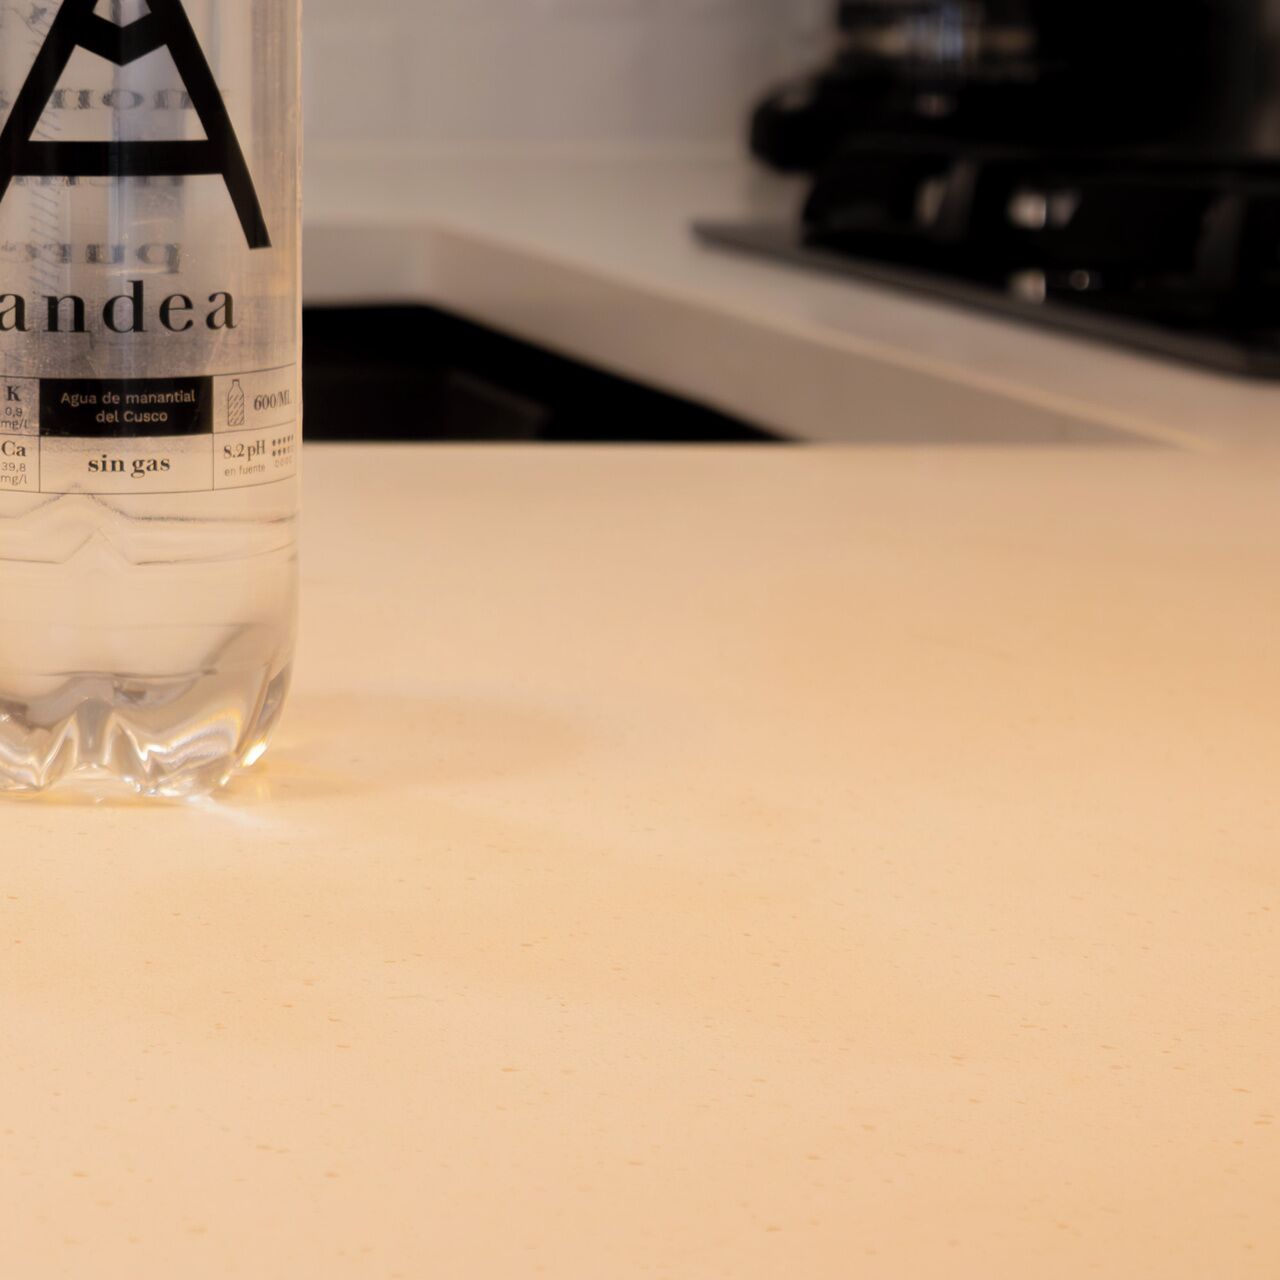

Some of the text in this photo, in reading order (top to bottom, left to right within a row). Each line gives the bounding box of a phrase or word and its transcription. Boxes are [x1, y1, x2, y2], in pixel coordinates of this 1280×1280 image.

[7, 385, 21, 402] K
[60, 390, 196, 407] Agua de manantial
[5, 407, 22, 418] 0,9
[95, 410, 168, 423] del Cusco
[1, 419, 28, 431] mg/l
[1, 440, 26, 457] Ca
[1, 461, 26, 473] 39,8
[88, 454, 170, 479] sin gas
[224, 463, 265, 477] en fuente
[0, 474, 27, 486] mg/l
